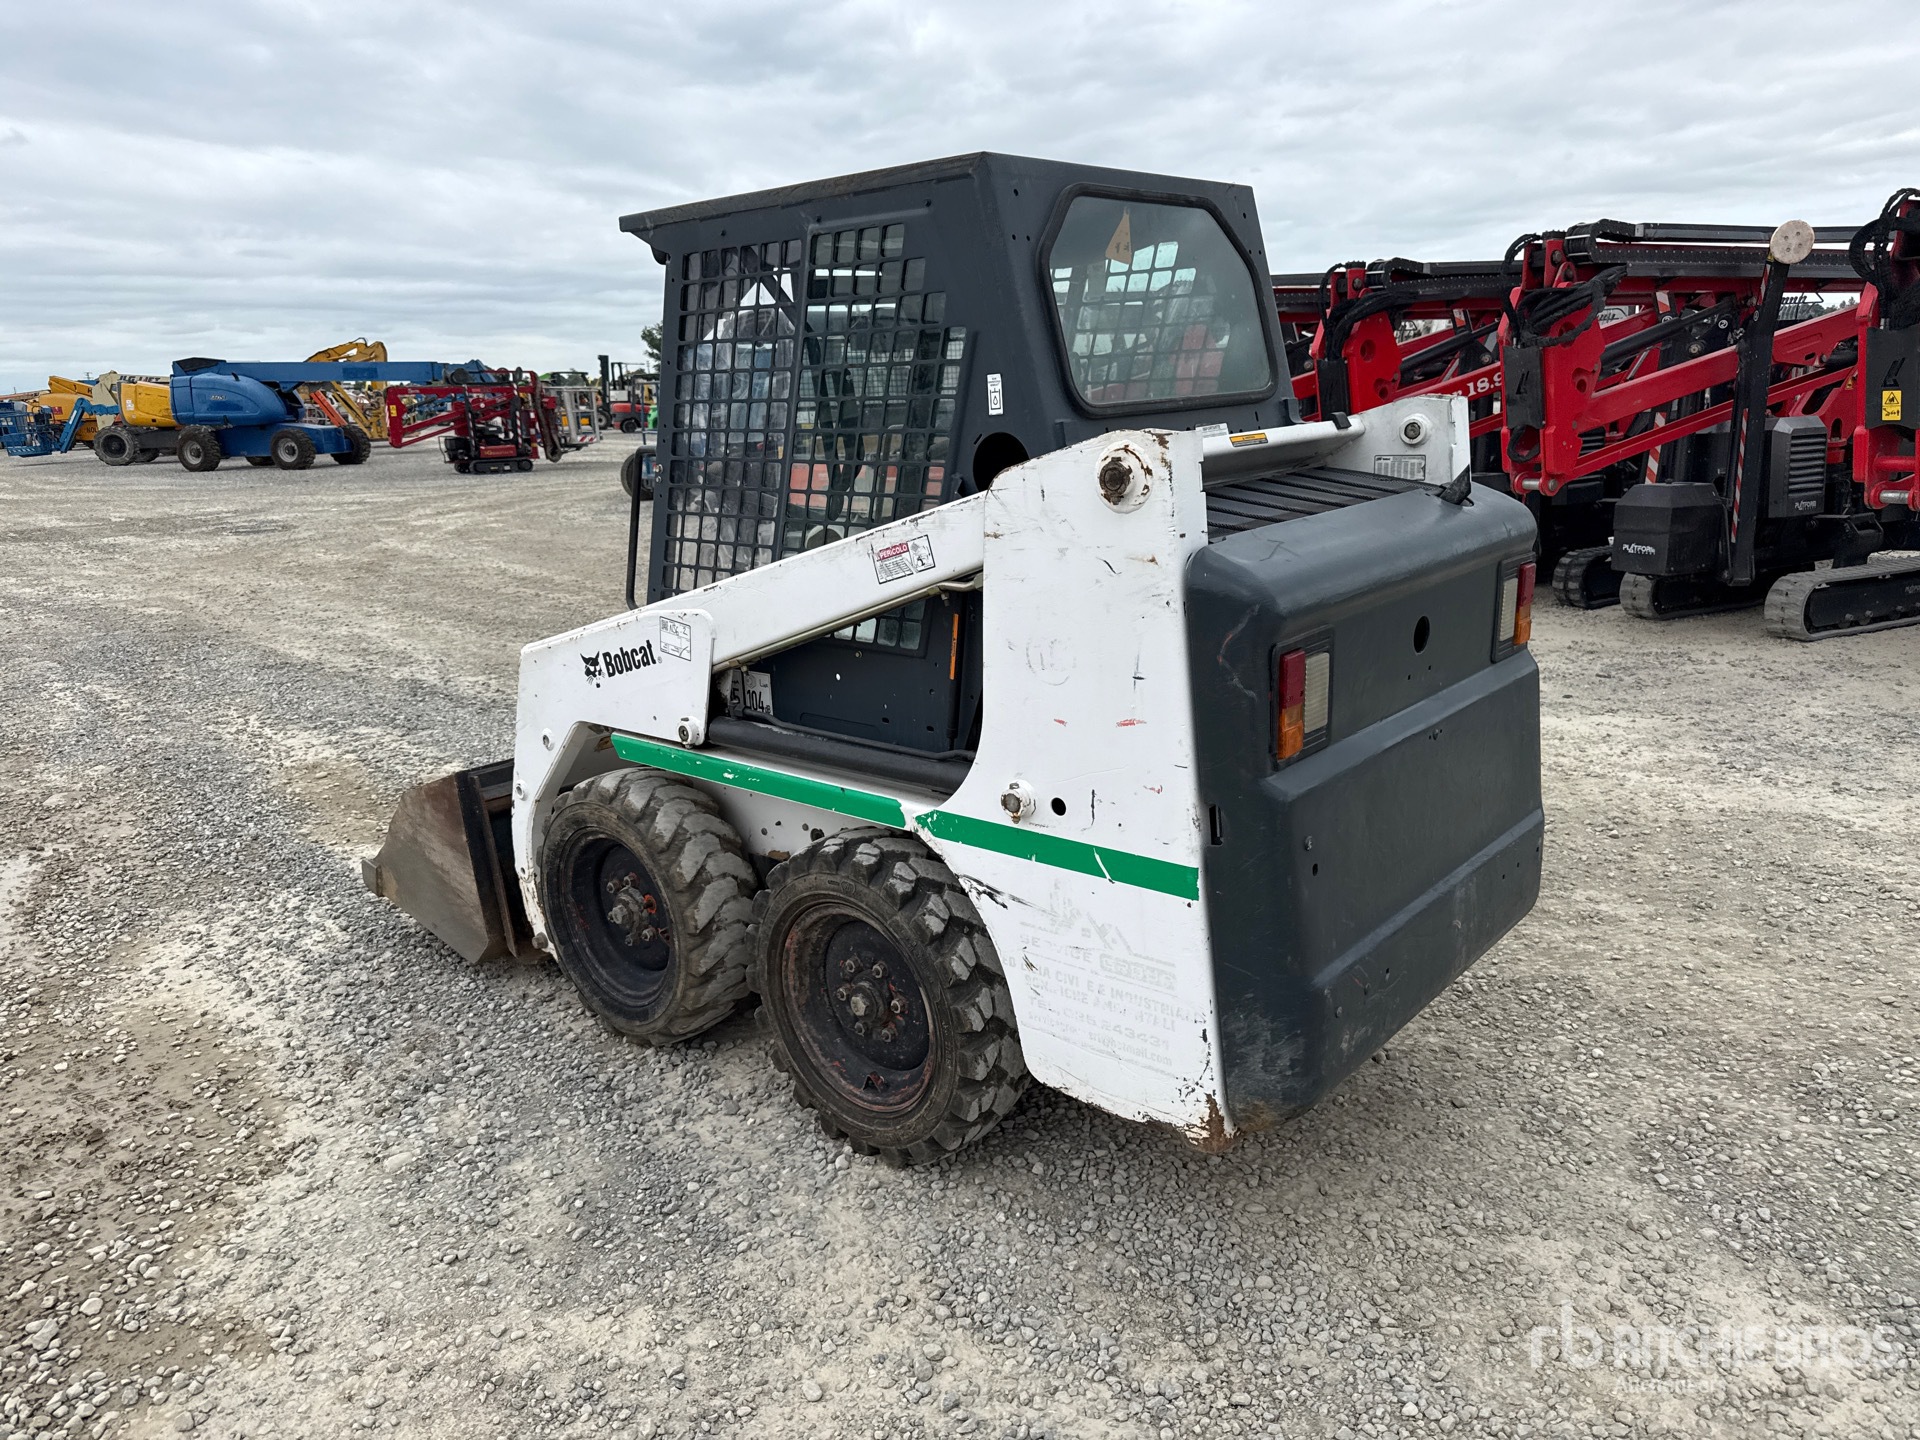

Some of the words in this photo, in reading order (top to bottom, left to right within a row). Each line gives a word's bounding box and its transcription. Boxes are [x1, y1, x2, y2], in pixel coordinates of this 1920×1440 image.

[879, 544, 908, 559] PERICOLO
[602, 639, 657, 678] Bobcat
[747, 690, 764, 713] 104
